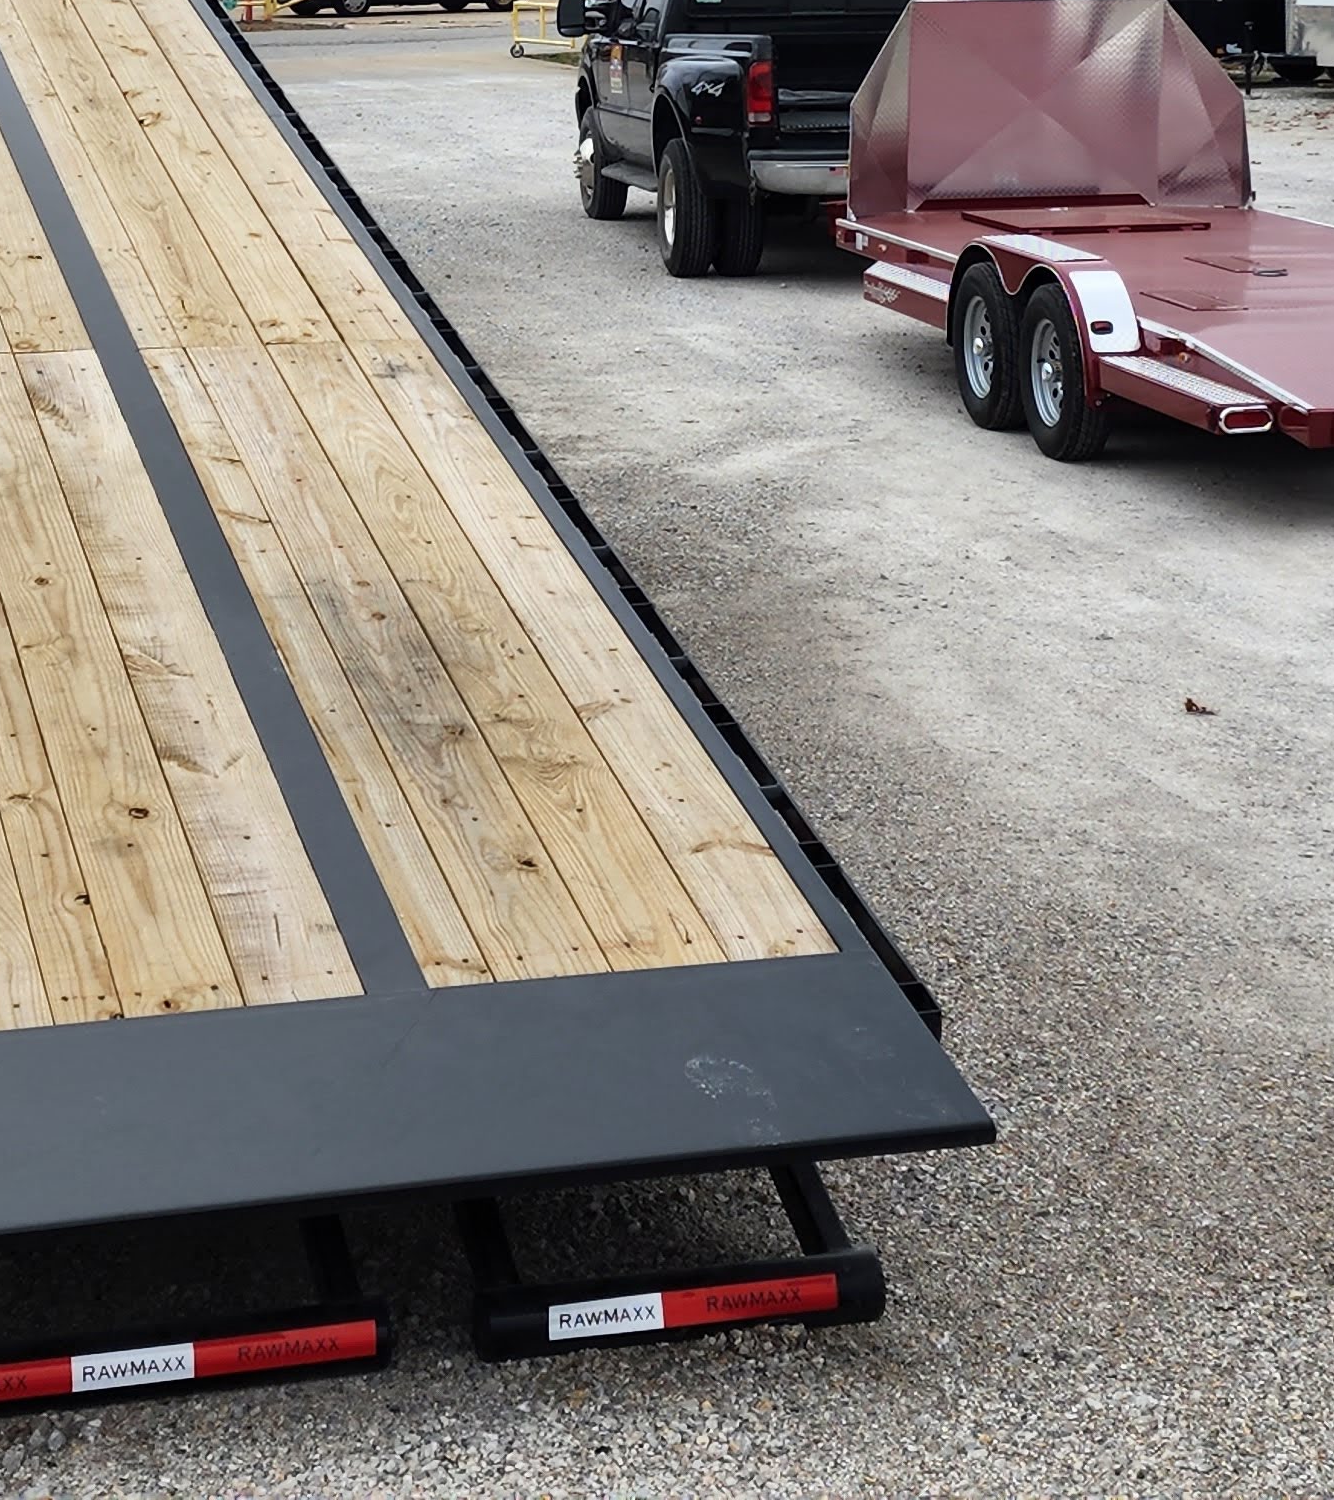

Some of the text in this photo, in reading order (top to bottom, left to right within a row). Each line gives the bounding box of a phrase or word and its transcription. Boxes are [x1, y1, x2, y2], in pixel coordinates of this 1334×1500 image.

[706, 1287, 802, 1312] RAWMAXX
[559, 1305, 657, 1329] RAWMAXX
[237, 1337, 341, 1363] RAWMAXX
[82, 1355, 187, 1382] RAWMAXX
